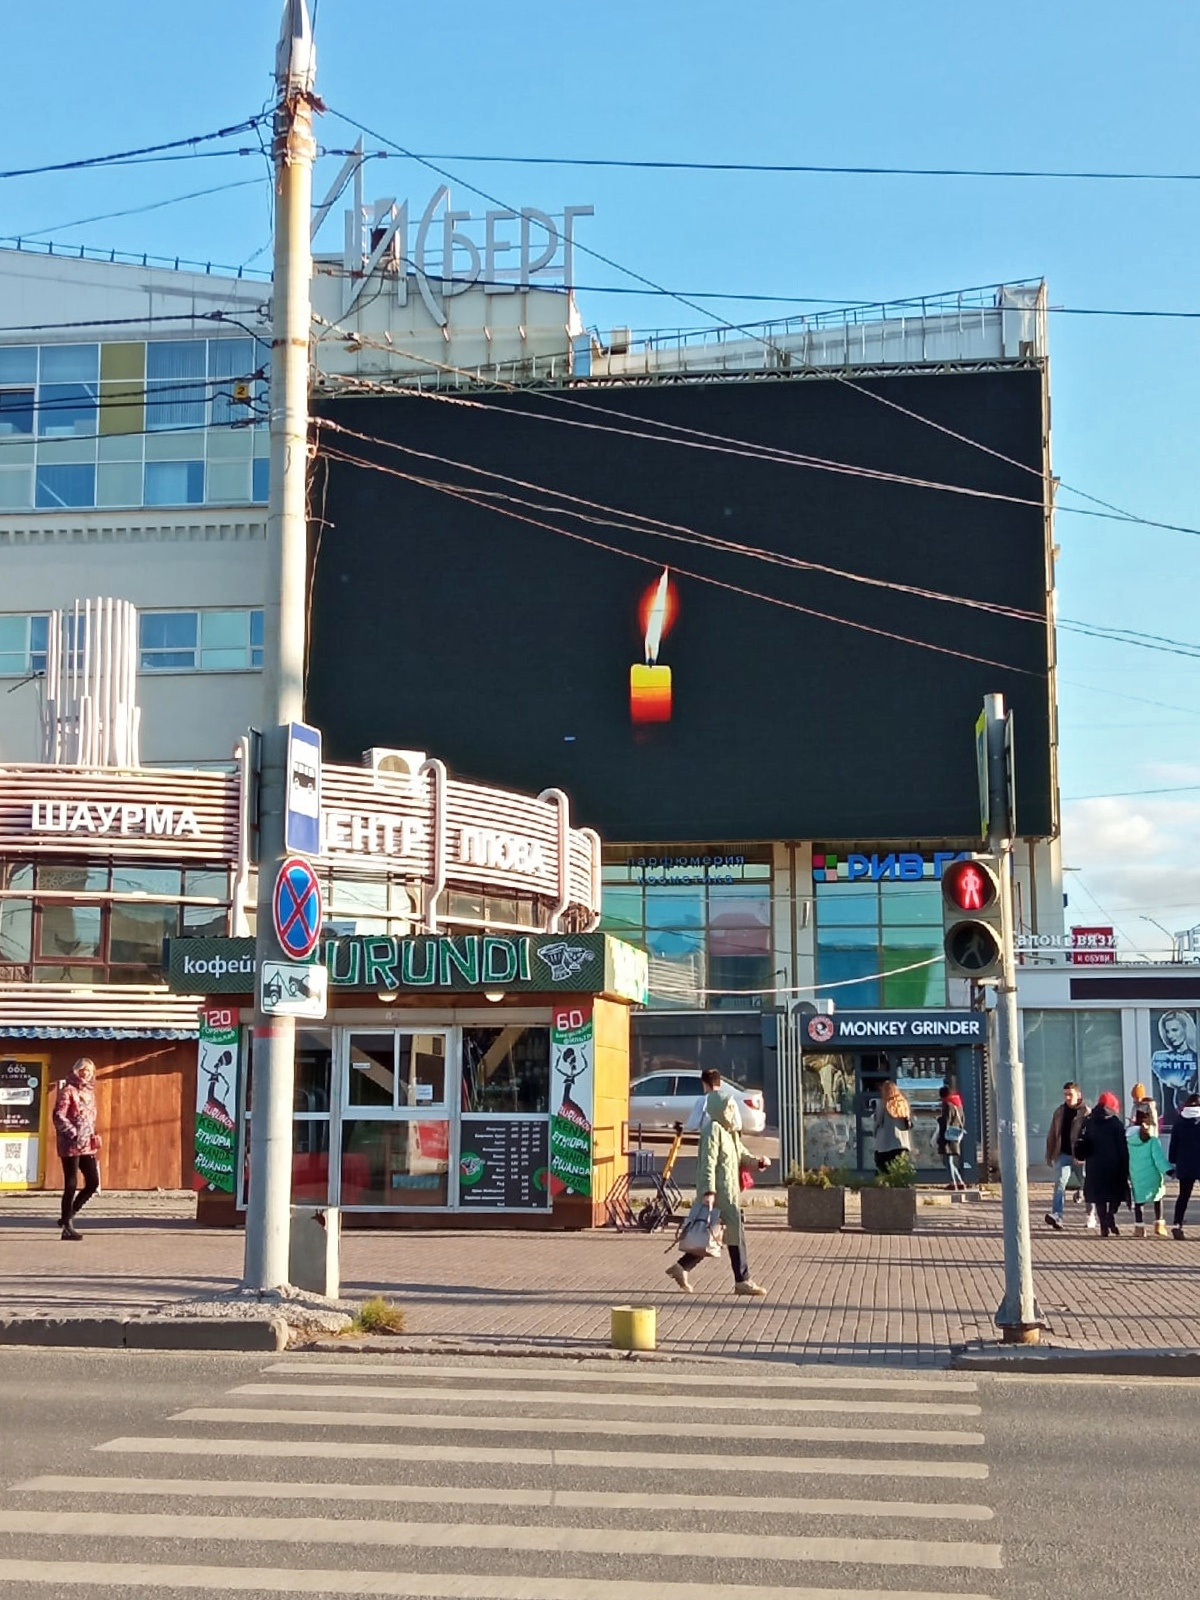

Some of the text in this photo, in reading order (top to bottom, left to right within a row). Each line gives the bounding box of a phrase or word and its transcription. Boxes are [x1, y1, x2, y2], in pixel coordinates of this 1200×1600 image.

[236, 386, 246, 396] 2
[31, 801, 202, 836] ШАУРМА
[320, 811, 427, 855] ЕНТР
[459, 828, 546, 874] ПЛОВА
[627, 855, 745, 870] парфюмерия
[847, 852, 973, 881] РИВ Г
[637, 874, 735, 886] косметика
[1012, 931, 1061, 947] алон
[202, 1010, 231, 1028] 120
[557, 1010, 583, 1032] 60
[839, 1021, 980, 1036] MONKEY GRINDER
[195, 1128, 231, 1148] ETHIOPIA
[552, 1131, 588, 1151] ETHIOPIA
[195, 1153, 233, 1172] RWANDA
[552, 1156, 591, 1175] RWANDA
